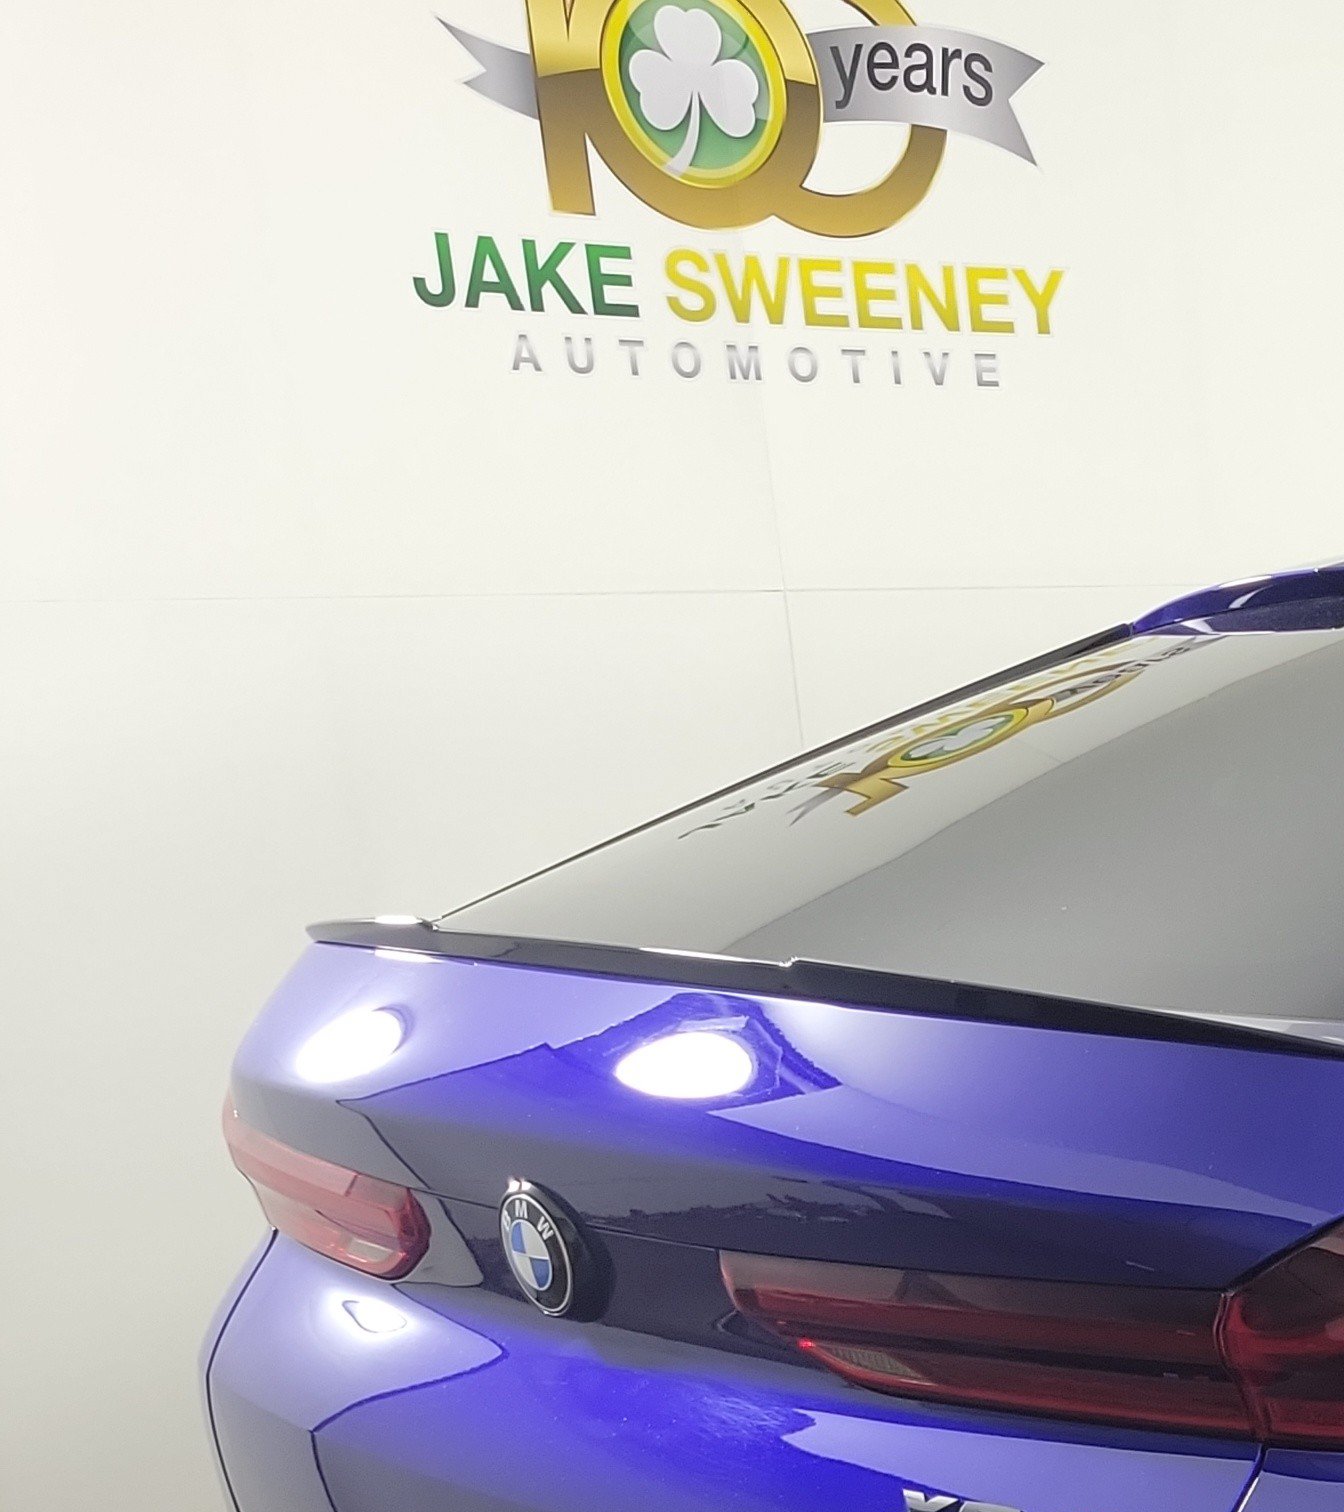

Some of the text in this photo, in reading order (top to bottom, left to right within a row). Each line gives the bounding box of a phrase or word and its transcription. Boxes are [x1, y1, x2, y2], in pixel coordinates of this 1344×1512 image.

[829, 41, 994, 110] years
[412, 232, 1064, 335] JAKE SWEENEY
[511, 334, 1000, 388] AUTOMOTIVE
[502, 1199, 555, 1241] BMW
